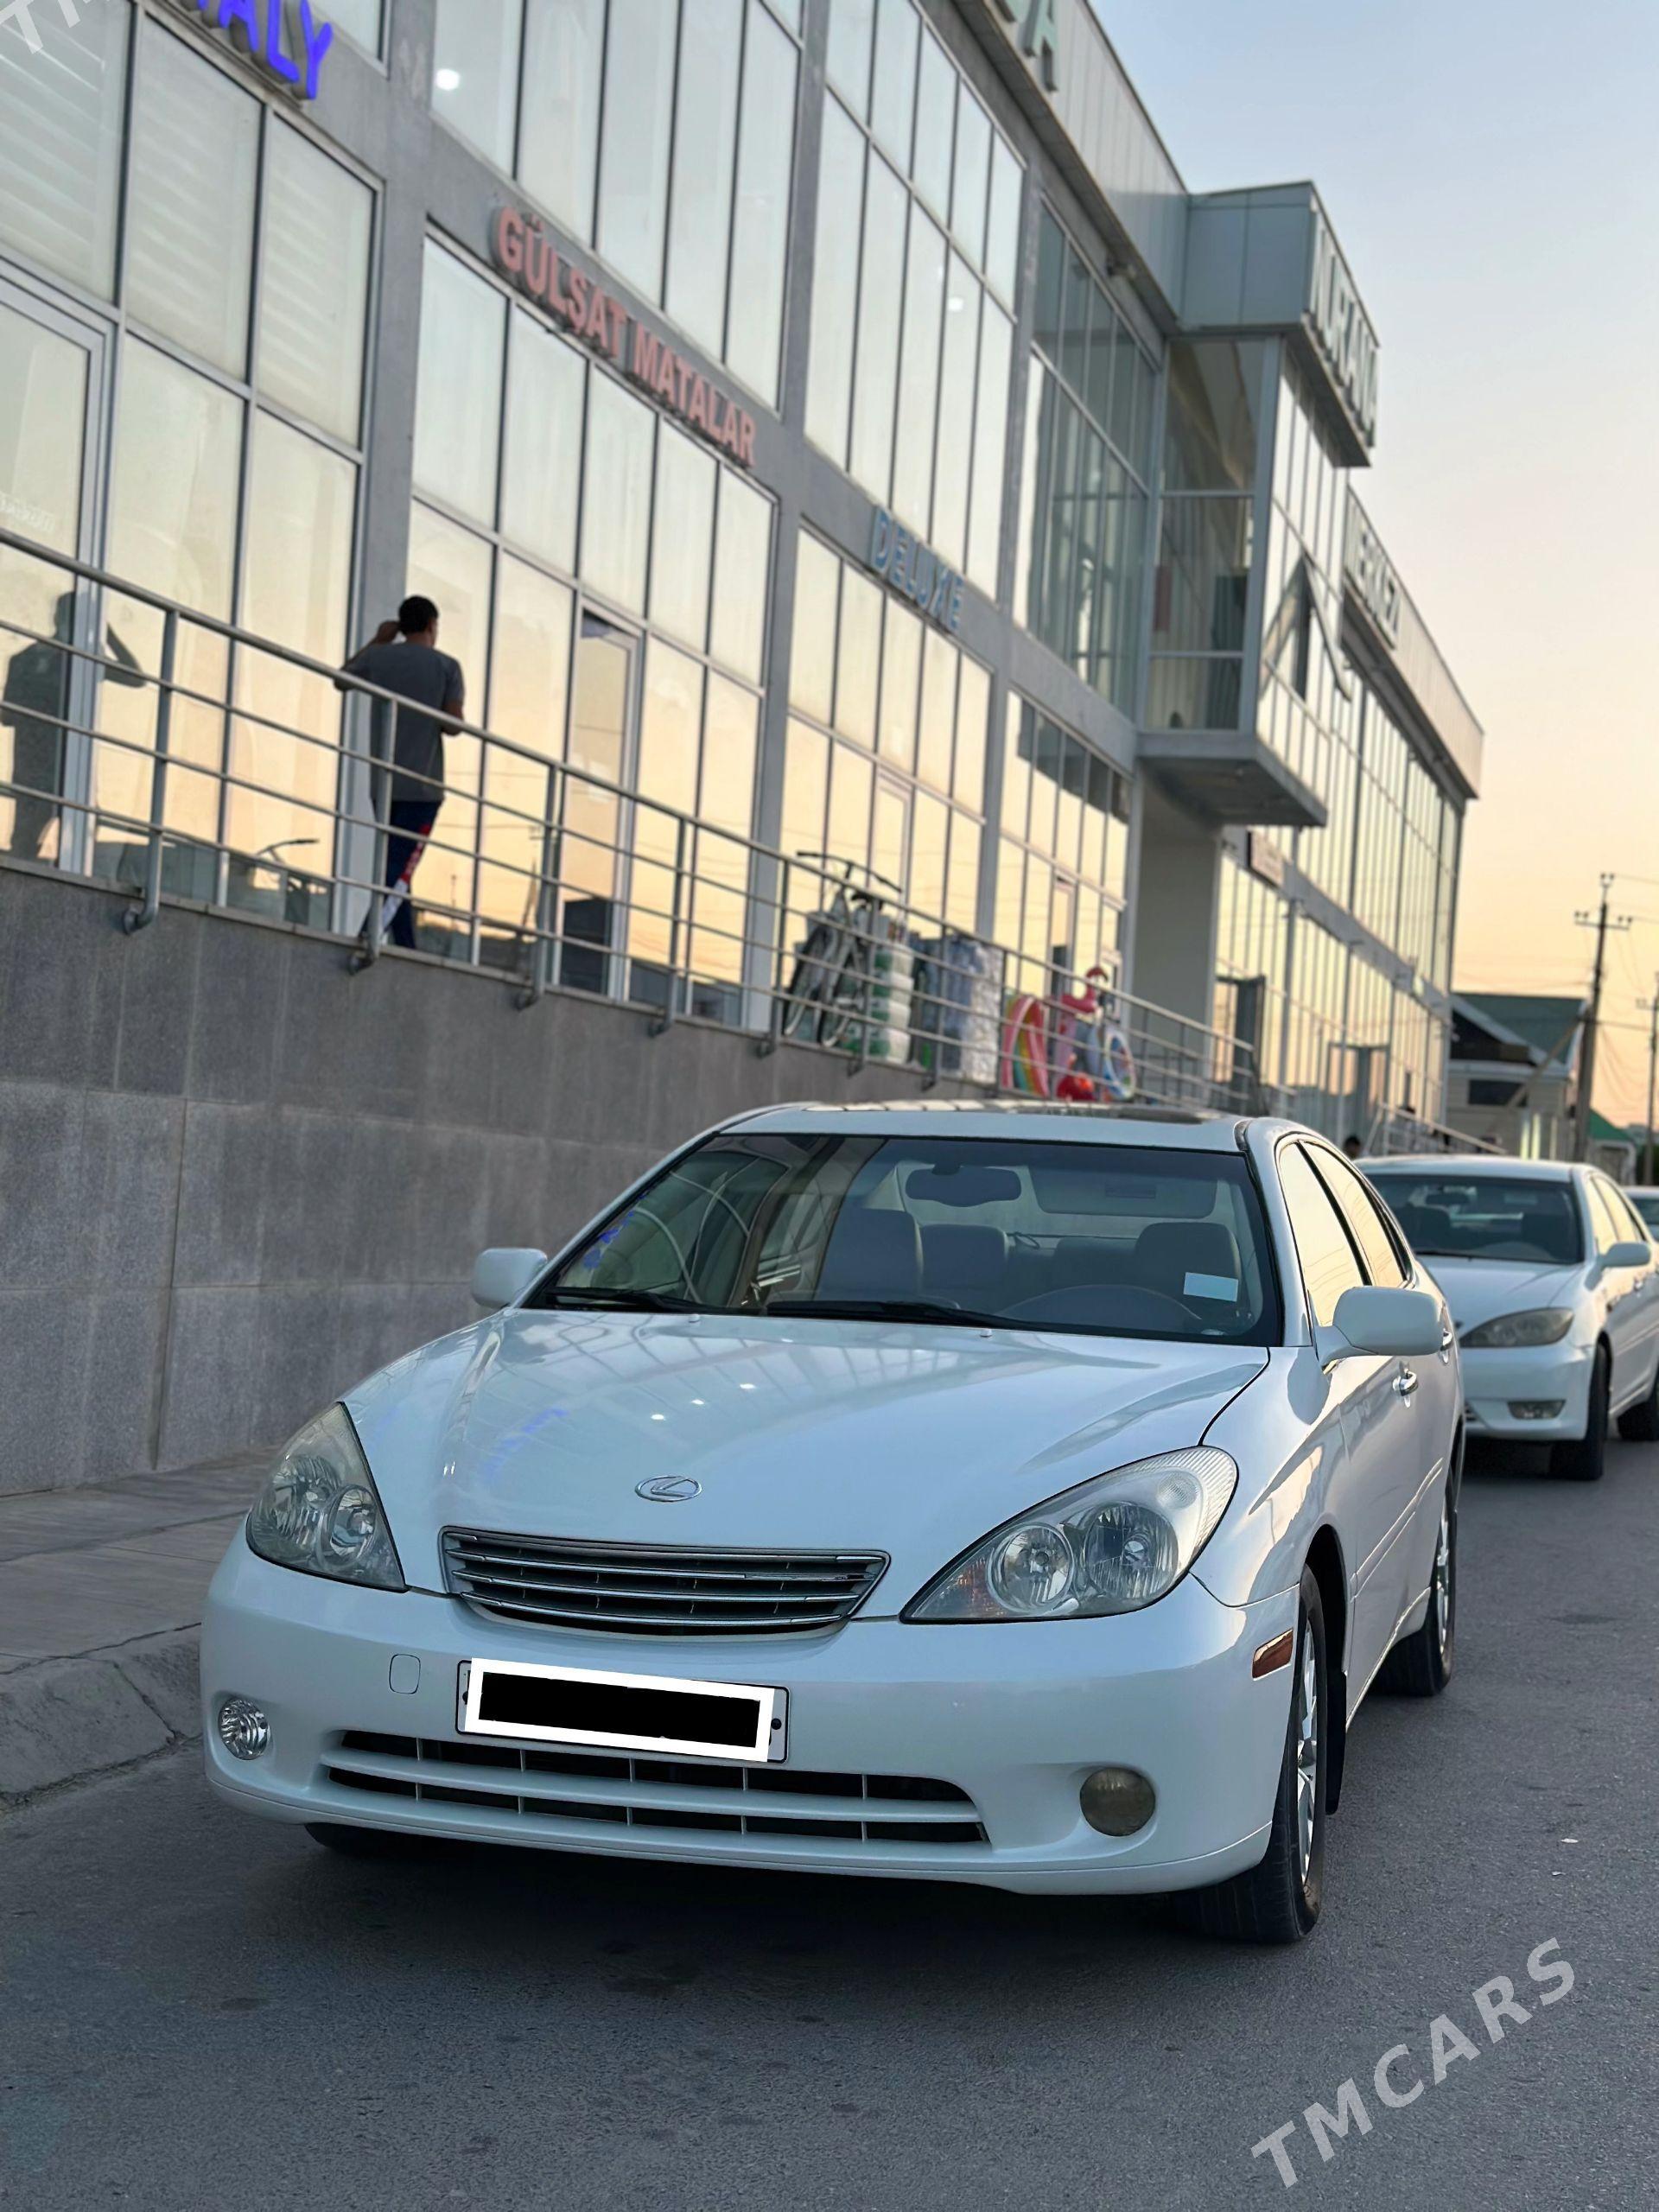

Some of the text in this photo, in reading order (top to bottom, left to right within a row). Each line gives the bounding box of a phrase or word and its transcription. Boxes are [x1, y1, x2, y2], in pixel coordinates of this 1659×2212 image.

[197, 0, 334, 100] ALY
[633, 321, 758, 469] MATALAR
[870, 504, 964, 632] DELUXE
